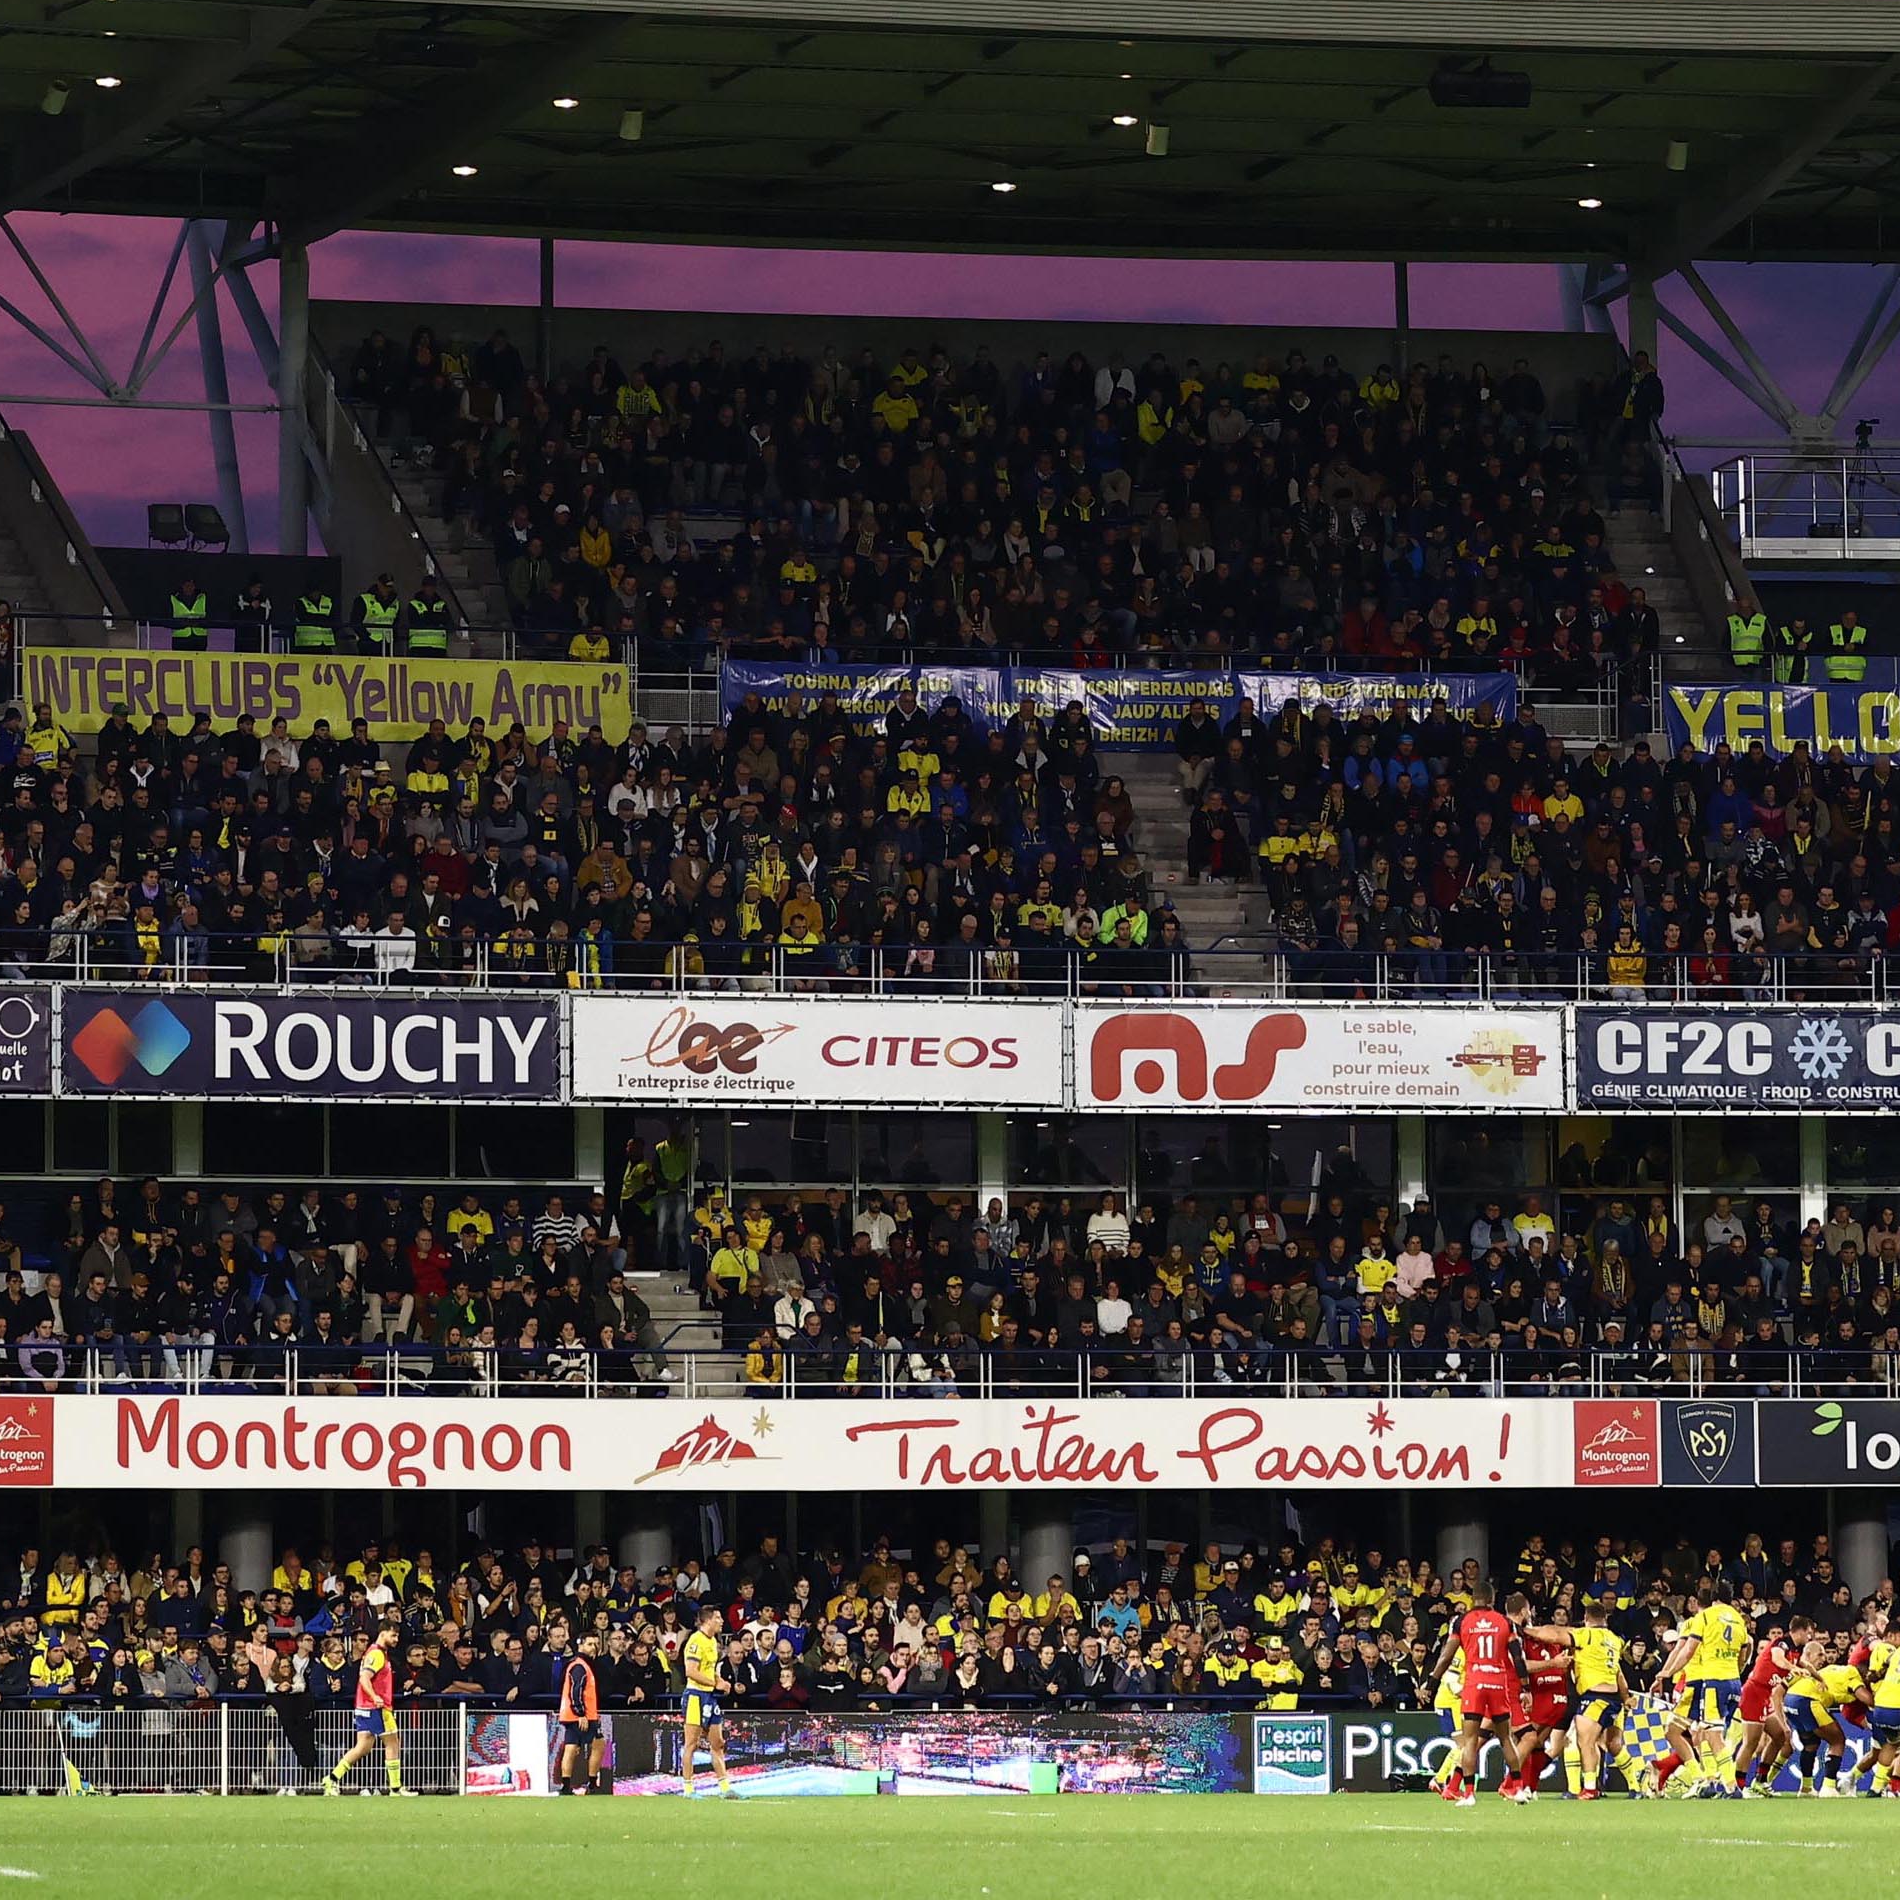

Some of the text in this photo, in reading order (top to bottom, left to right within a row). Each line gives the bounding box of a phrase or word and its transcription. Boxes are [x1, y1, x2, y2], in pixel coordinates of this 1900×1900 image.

[29, 654, 301, 719] INTERCLUBS
[784, 673, 852, 690] TOURNA
[1085, 679, 1235, 697] MONTFERRANDAIS
[1113, 704, 1220, 720] JAUD'ALS
[1100, 727, 1159, 743] BREIZH
[1343, 1019, 1417, 1038] Le sable,
[214, 1000, 548, 1084] ROUCHY
[1358, 1039, 1403, 1057] l'eau,
[1596, 1020, 1773, 1075] CF2C
[821, 1035, 1019, 1070] CITEOS
[1332, 1060, 1430, 1079] pour mieux
[617, 1073, 796, 1094] l'entreprise électrique
[1303, 1080, 1460, 1098] construire demain
[1591, 1081, 1643, 1098] GÉNIE
[1646, 1084, 1748, 1101] CLIMATIQUE
[1762, 1084, 1811, 1100] FROID
[117, 1397, 571, 1487] Montrognon
[846, 1405, 1159, 1485] Traiteur
[1581, 1449, 1650, 1464] Montrognon
[1477, 1635, 1493, 1659] 11
[1260, 1726, 1324, 1748] l'esprit
[1260, 1745, 1324, 1765] piscine
